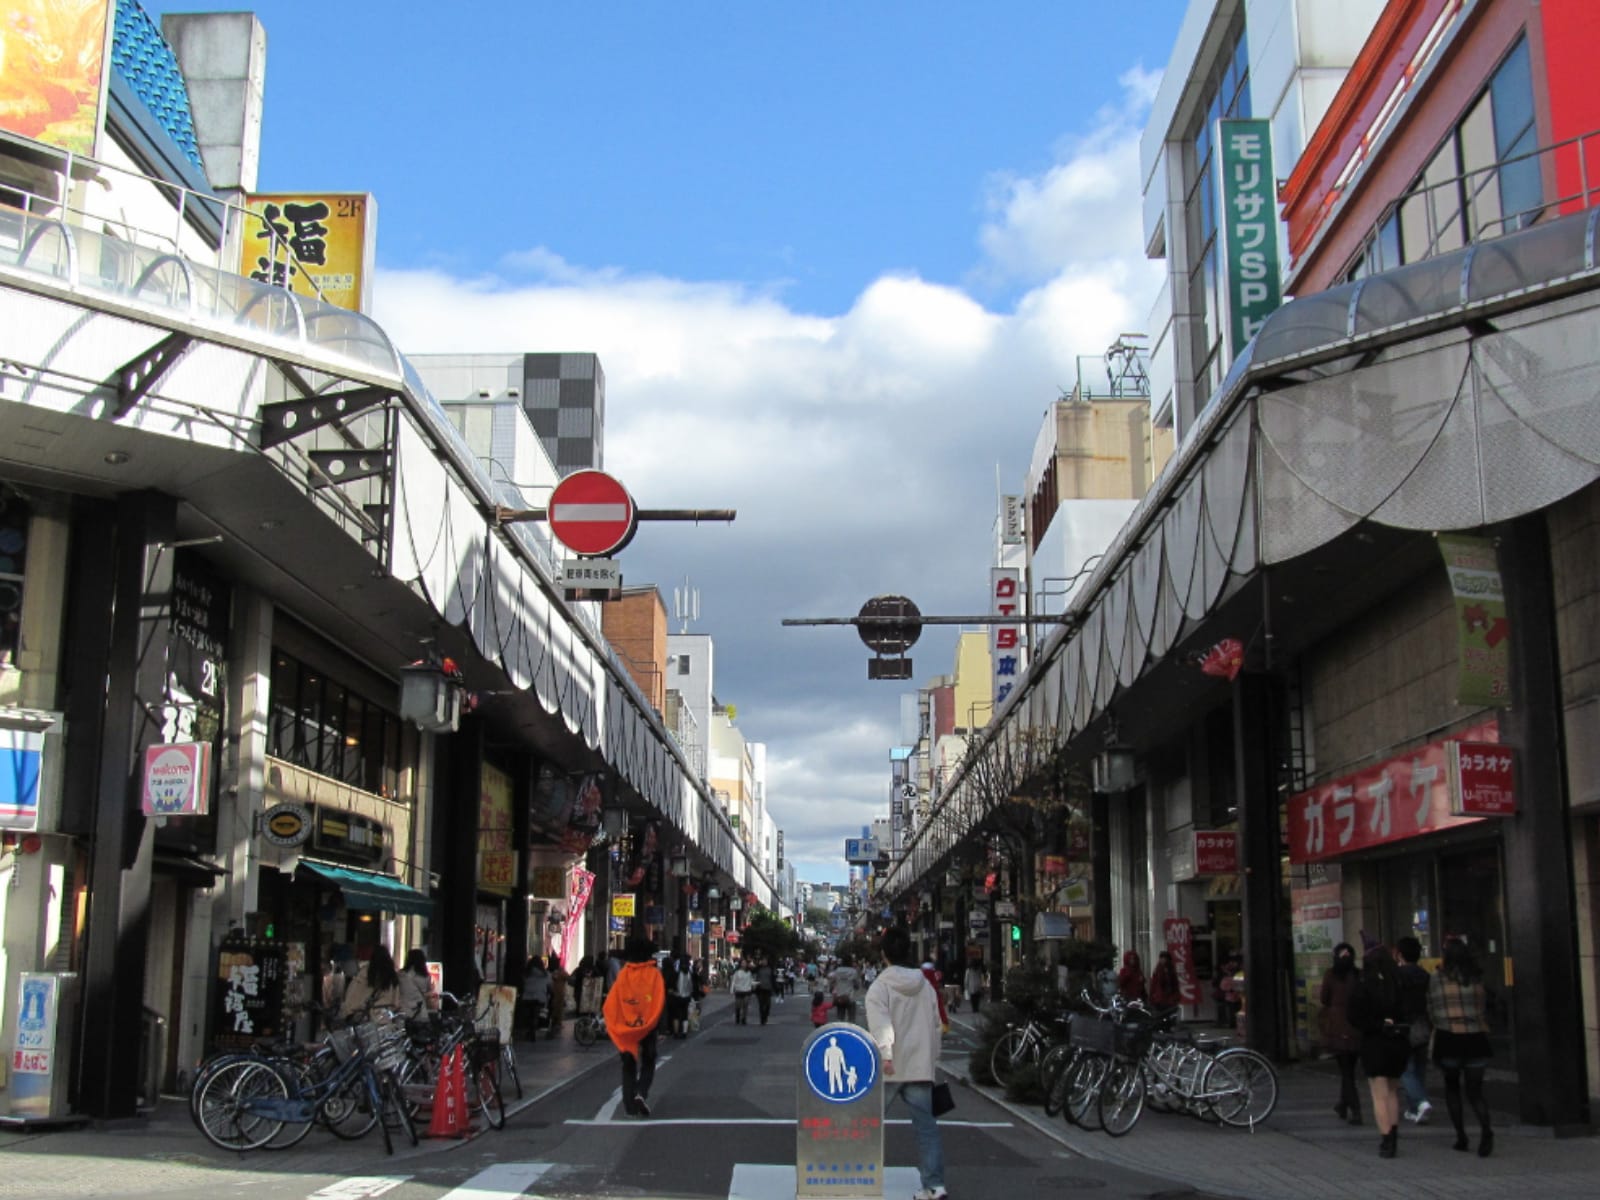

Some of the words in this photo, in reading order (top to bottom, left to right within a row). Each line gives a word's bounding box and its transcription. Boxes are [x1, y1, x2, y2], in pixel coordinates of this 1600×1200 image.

[337, 199, 361, 218] 2F
[1460, 754, 1513, 774] カラオケ
[1304, 757, 1438, 856] カラオケ
[1197, 837, 1235, 849] カラオケ
